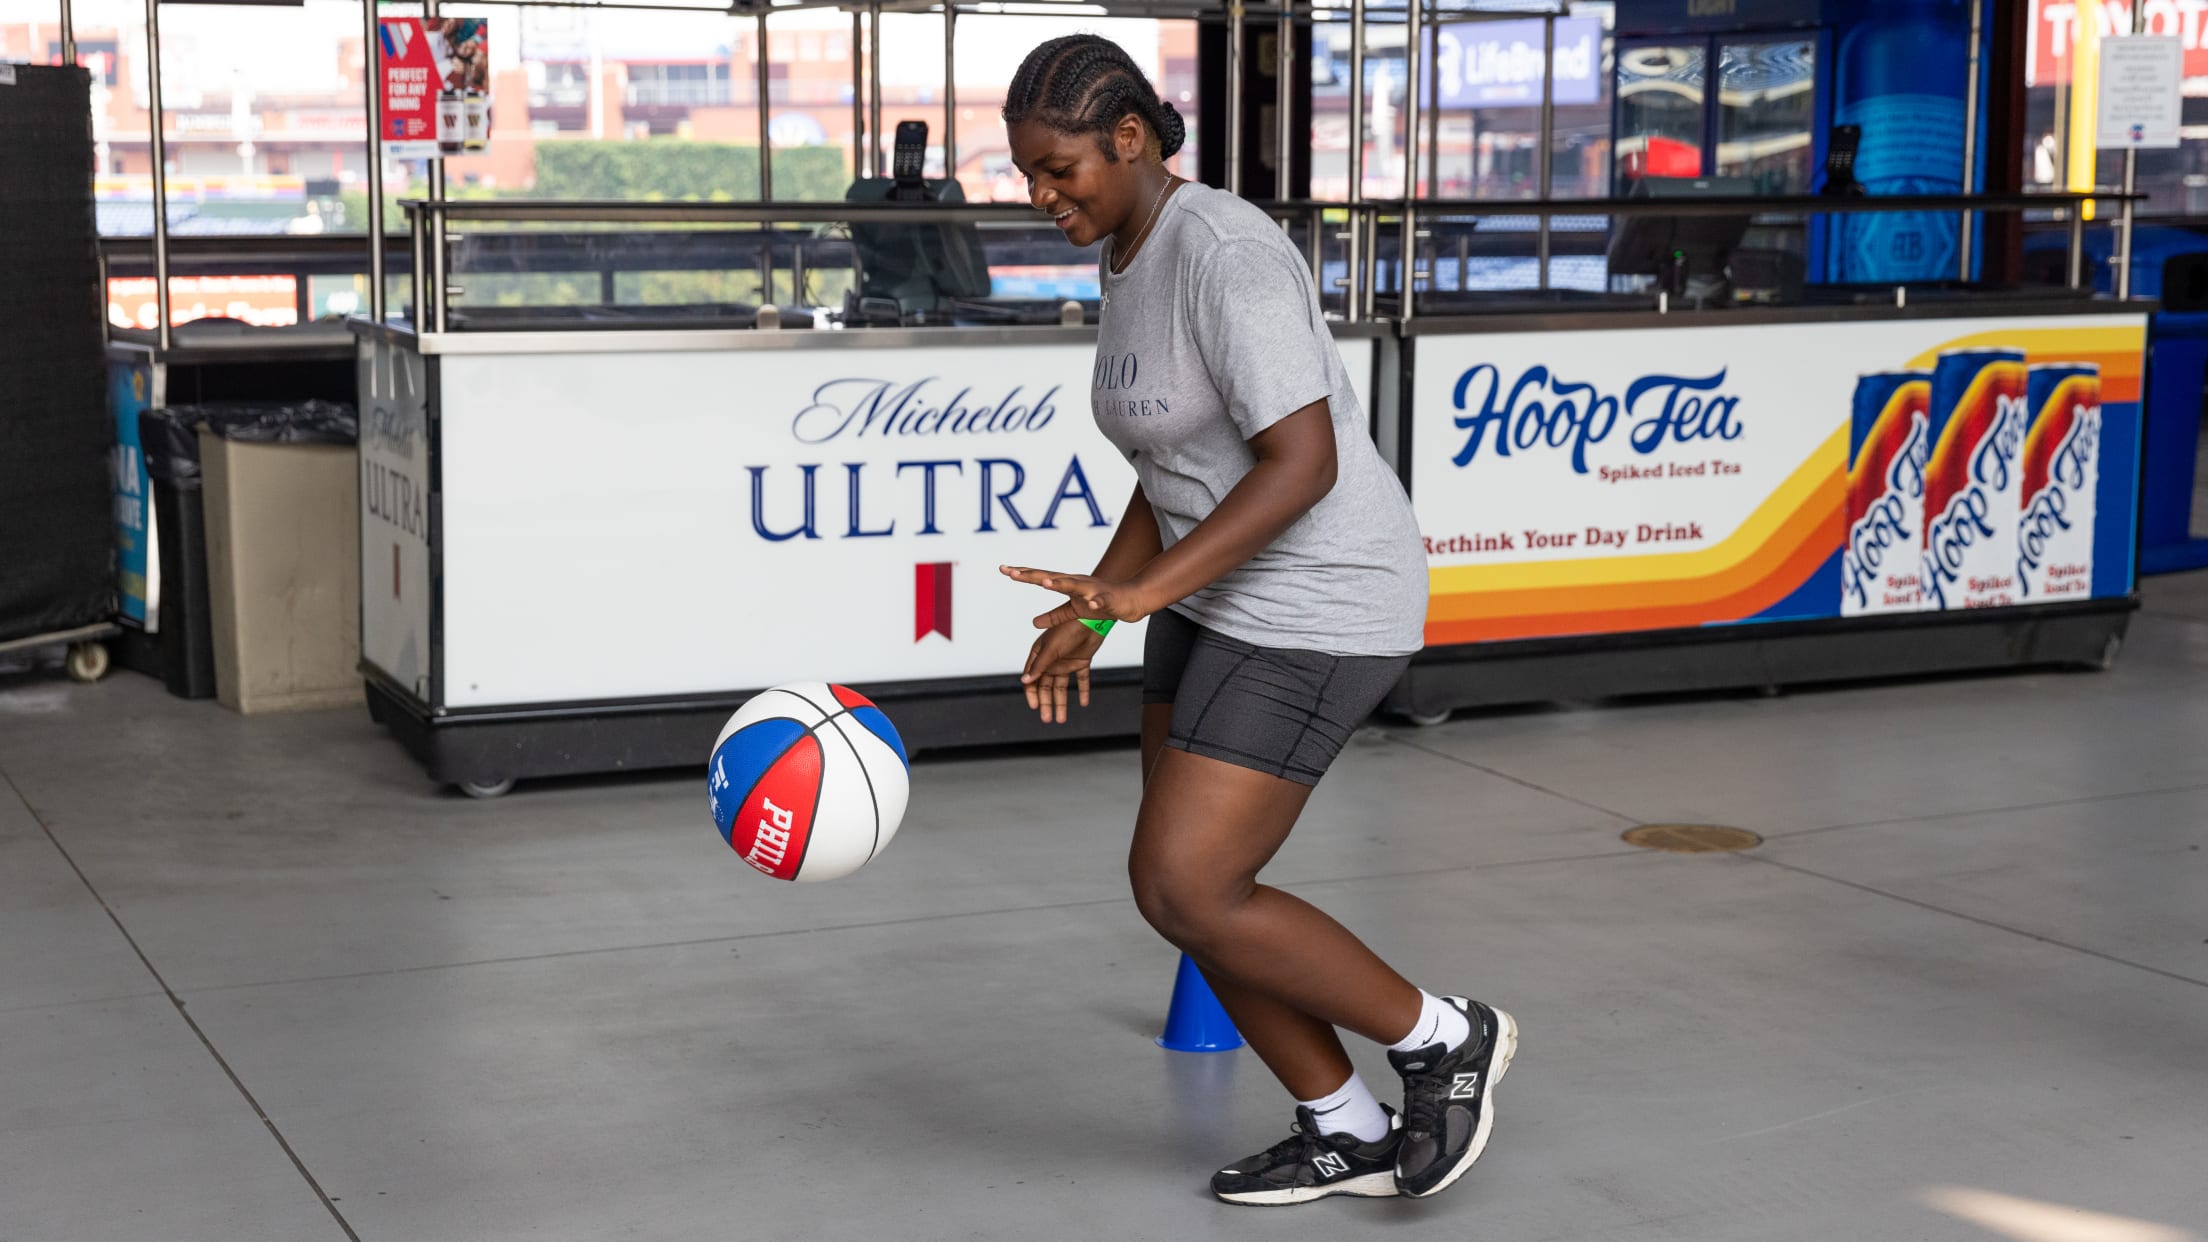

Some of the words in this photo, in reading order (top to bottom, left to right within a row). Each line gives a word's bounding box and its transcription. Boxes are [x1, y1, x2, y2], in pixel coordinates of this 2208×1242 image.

[2043, 0, 2208, 57] TOYOT
[388, 67, 428, 82] PERFECT
[388, 82, 408, 96] FOR
[408, 82, 427, 96] ANY
[1095, 352, 1138, 391] OLO
[792, 375, 1063, 445] Michelob
[1106, 398, 1169, 417] LAUREN
[1451, 363, 1618, 475] Hoop
[1624, 364, 1744, 455] Tea
[1599, 463, 1663, 484] Spiked
[1669, 461, 1706, 479] Iced
[1713, 460, 1741, 476] Tea
[365, 458, 425, 541] ULTRA
[744, 453, 1111, 542] ULTRA
[1421, 531, 1515, 556] Rethink
[1523, 529, 1577, 550] Your
[1585, 525, 1629, 549] Day
[1637, 521, 1703, 544] Drink
[1450, 1072, 1479, 1099] N
[1313, 1151, 1350, 1178] N
